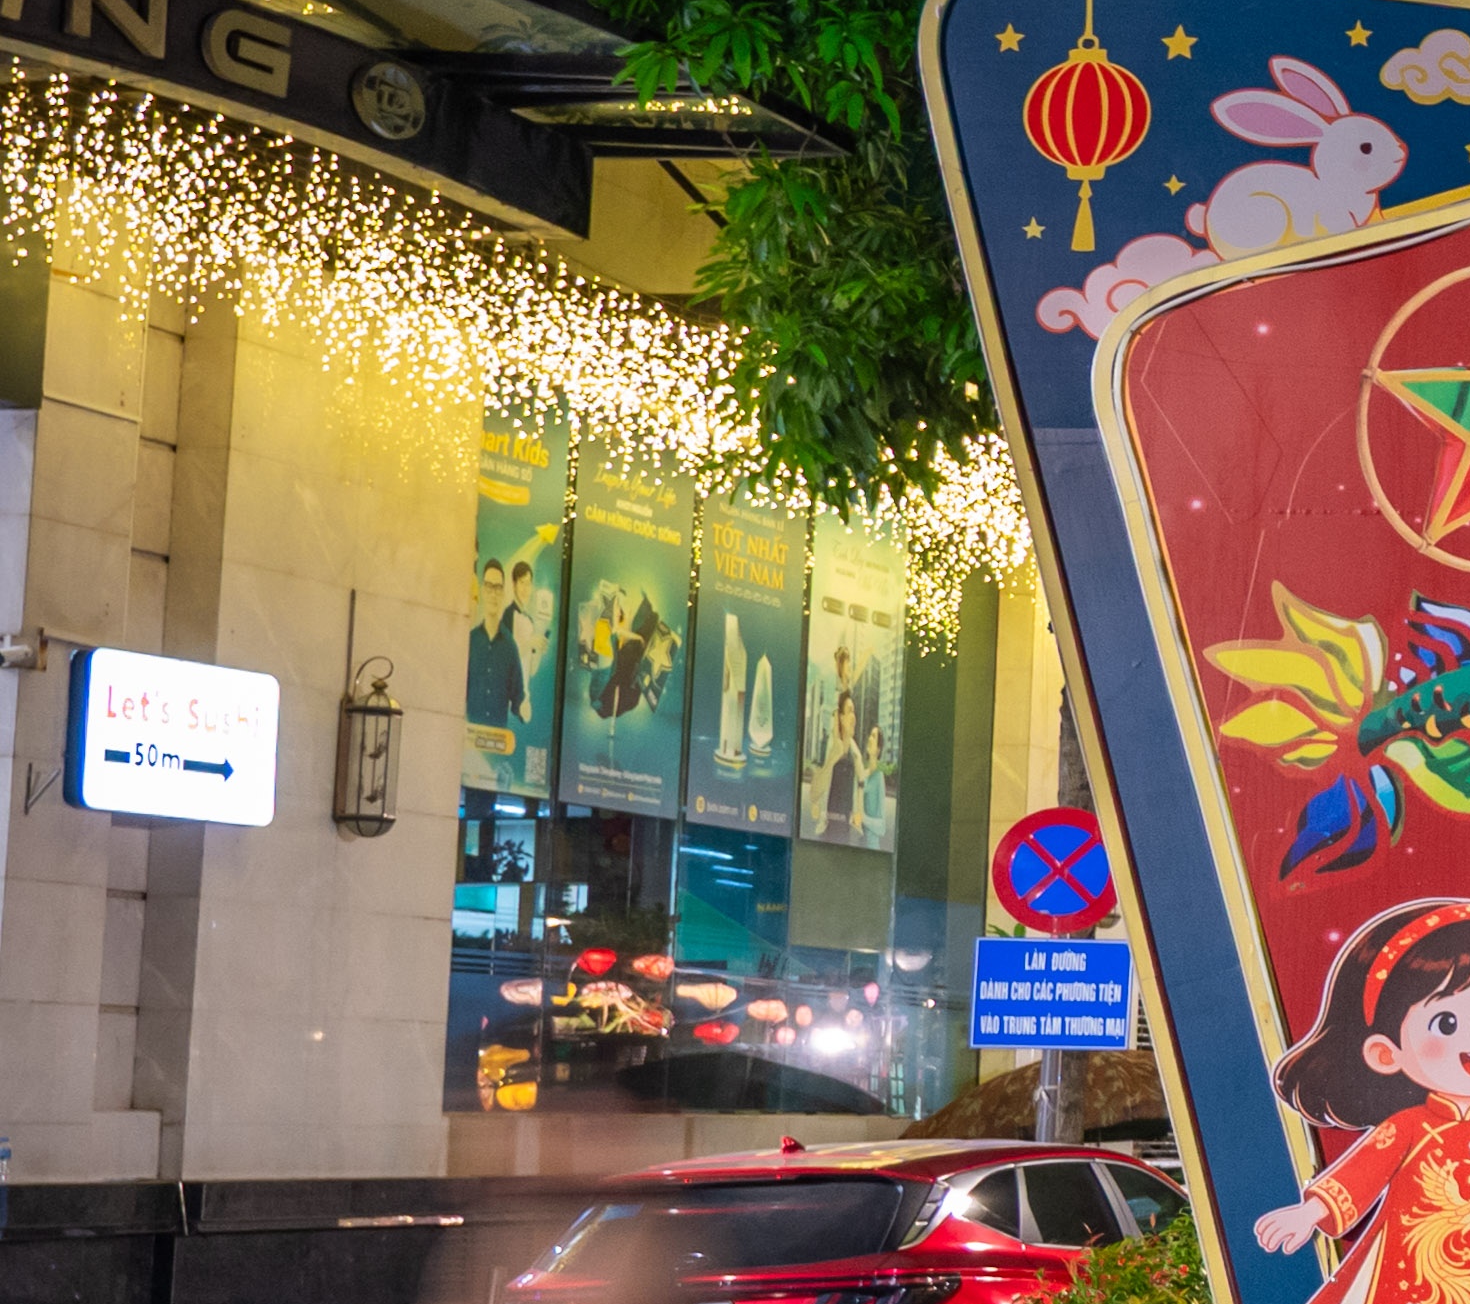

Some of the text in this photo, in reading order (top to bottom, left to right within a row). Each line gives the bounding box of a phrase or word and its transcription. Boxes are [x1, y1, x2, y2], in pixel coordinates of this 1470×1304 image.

[712, 519, 789, 566] TỐT NHẤT
[714, 550, 784, 591] VIỆT NAM
[107, 685, 170, 724] Let's
[135, 742, 180, 770] 50m
[1024, 948, 1046, 971] LÀN
[980, 978, 1009, 1000] DÀNH
[1010, 981, 1032, 1001] CHO
[1033, 979, 1054, 1001] CÁC
[980, 1012, 1000, 1034] VÀO
[1003, 1016, 1037, 1035] TRUNG
[1040, 1013, 1062, 1035] TÂM
